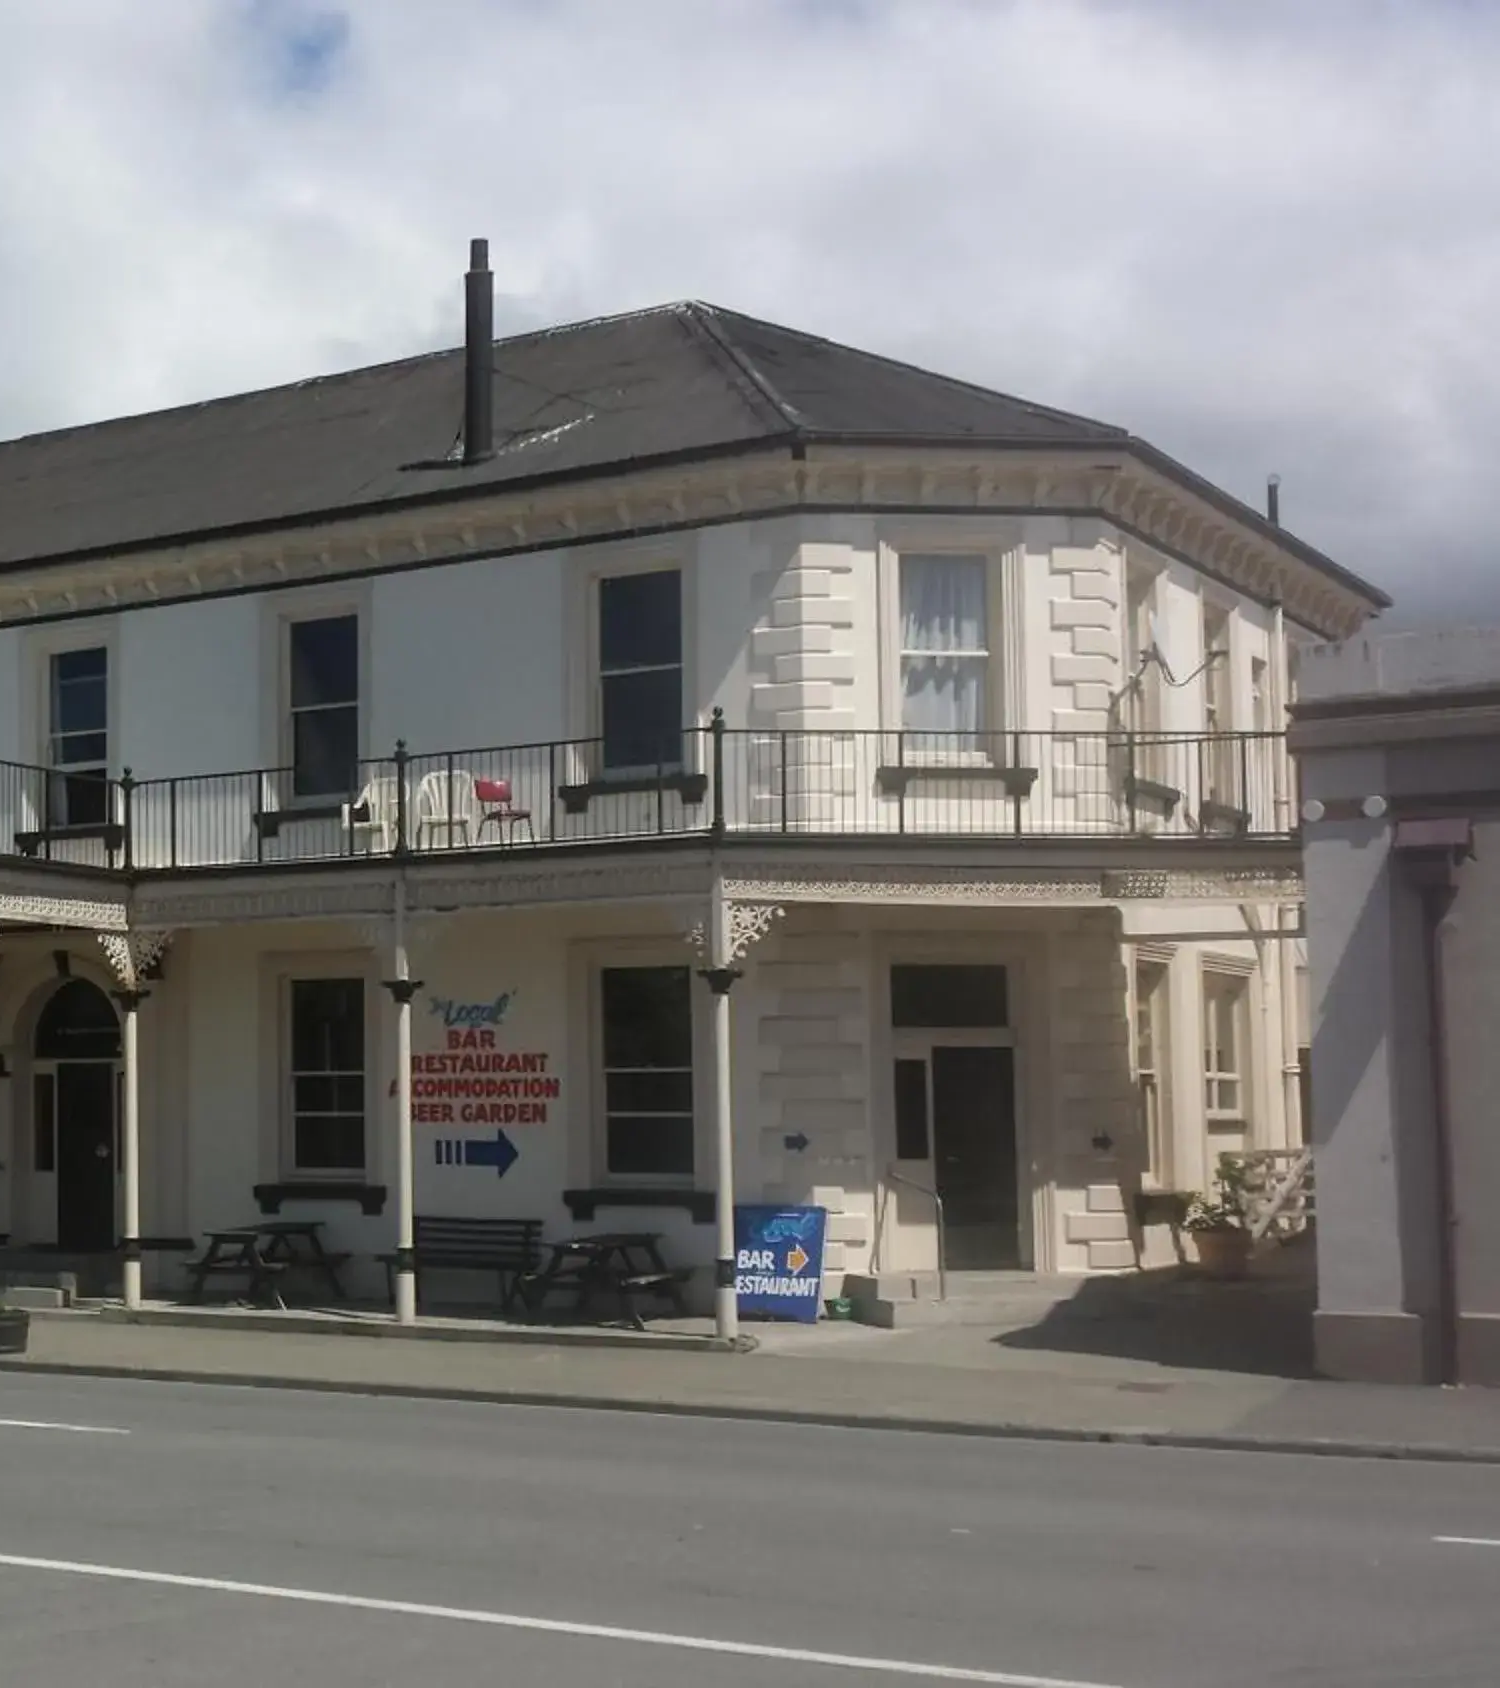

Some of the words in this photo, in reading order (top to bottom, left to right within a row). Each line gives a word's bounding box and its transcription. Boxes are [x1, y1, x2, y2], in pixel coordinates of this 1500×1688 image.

[446, 1028, 496, 1049] BAR
[411, 1052, 549, 1074] RESTAURANT
[389, 1076, 561, 1098] ACOMMODATION
[460, 1102, 548, 1124] GARDEN
[737, 1248, 775, 1271] BAR
[735, 1274, 819, 1297] ESTAURANT
